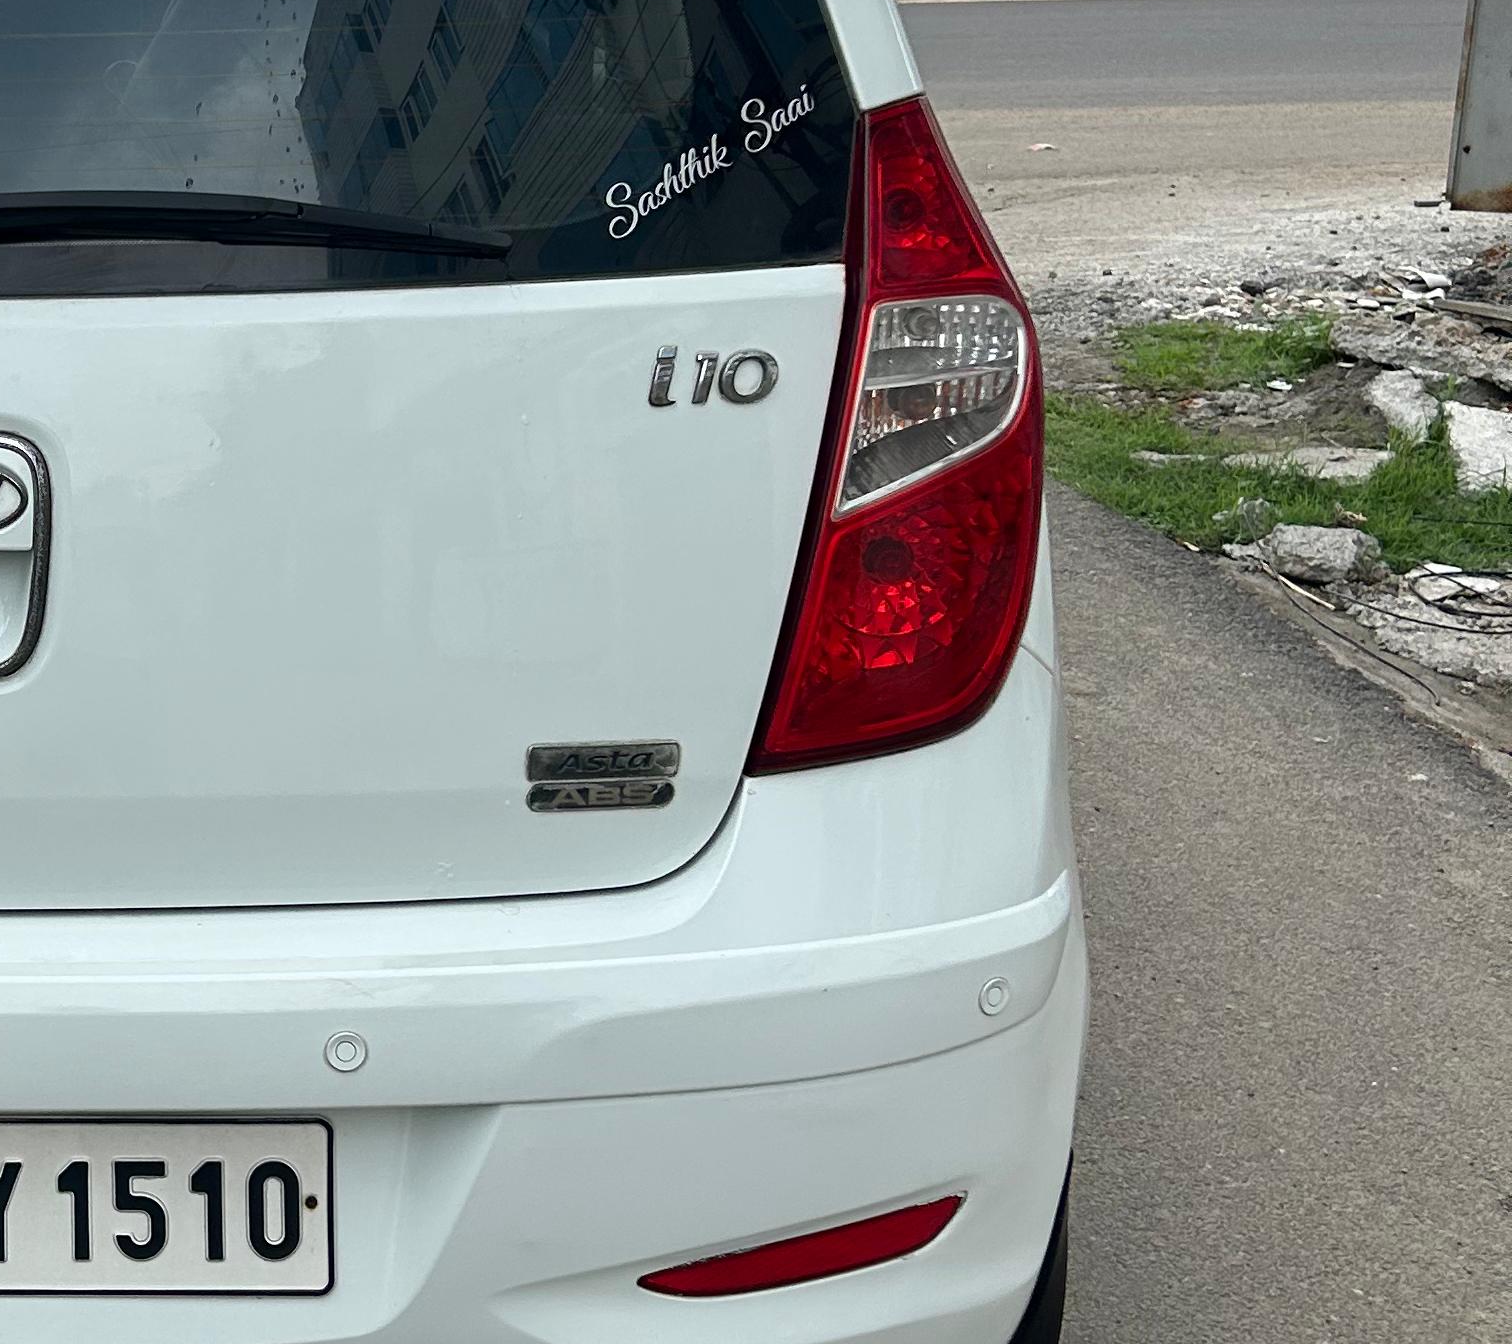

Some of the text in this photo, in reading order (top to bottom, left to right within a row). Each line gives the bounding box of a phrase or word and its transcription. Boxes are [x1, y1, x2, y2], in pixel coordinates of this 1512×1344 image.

[605, 84, 815, 239] Sashthik Saai
[648, 345, 779, 407] i10
[556, 750, 655, 774] Asta
[548, 783, 660, 807] ABS
[57, 1159, 304, 1263] 1510
